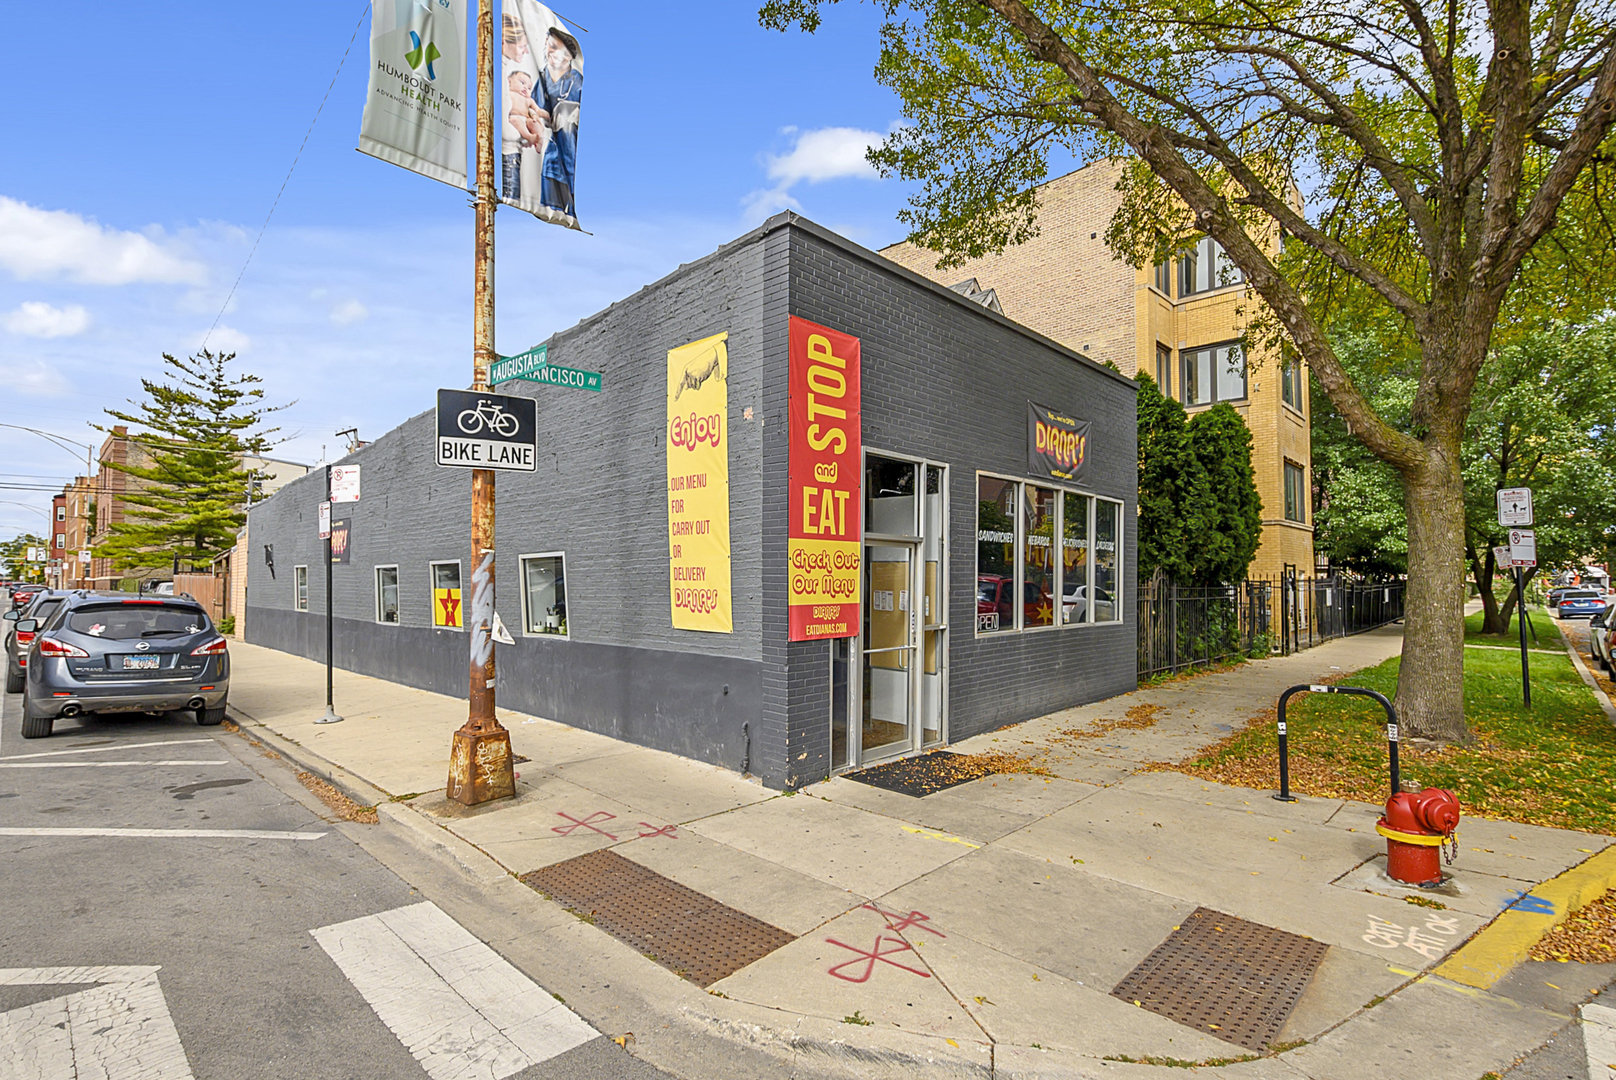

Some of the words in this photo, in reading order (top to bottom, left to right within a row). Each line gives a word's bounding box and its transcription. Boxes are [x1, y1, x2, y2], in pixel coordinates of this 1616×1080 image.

[377, 60, 436, 96] HUMBOLDT
[439, 92, 462, 112] PARK
[401, 84, 441, 112] HEALTH
[376, 88, 414, 109] ADVANCING
[416, 106, 438, 120] HEALTH
[439, 117, 461, 131] EQUITY
[496, 353, 534, 381] AUGUSTA
[533, 351, 545, 365] BLVD
[525, 366, 584, 387] ANCISCO
[588, 376, 597, 386] AV
[806, 333, 847, 455] STOP
[670, 411, 721, 452] Enjoy
[442, 441, 481, 461] BIKE
[488, 445, 532, 465] LANE
[1035, 420, 1086, 469] DIANA'S
[671, 477, 685, 491] OUR
[685, 473, 707, 489] MENU
[815, 461, 837, 482] and
[671, 499, 685, 514] FOR
[802, 485, 850, 536] EAT
[672, 521, 695, 536] CARRY
[695, 519, 710, 535] OUT
[977, 529, 1014, 544] SANDWICHES
[331, 528, 348, 555] ANA'S
[673, 544, 682, 559] OR
[673, 566, 706, 581] DELIVERY
[791, 548, 833, 574] Check
[833, 550, 860, 570] Out
[792, 574, 819, 595] Our
[822, 574, 856, 598] Menu
[674, 588, 718, 615] DIANA'S
[805, 622, 847, 636] EATDIANAS.COM
